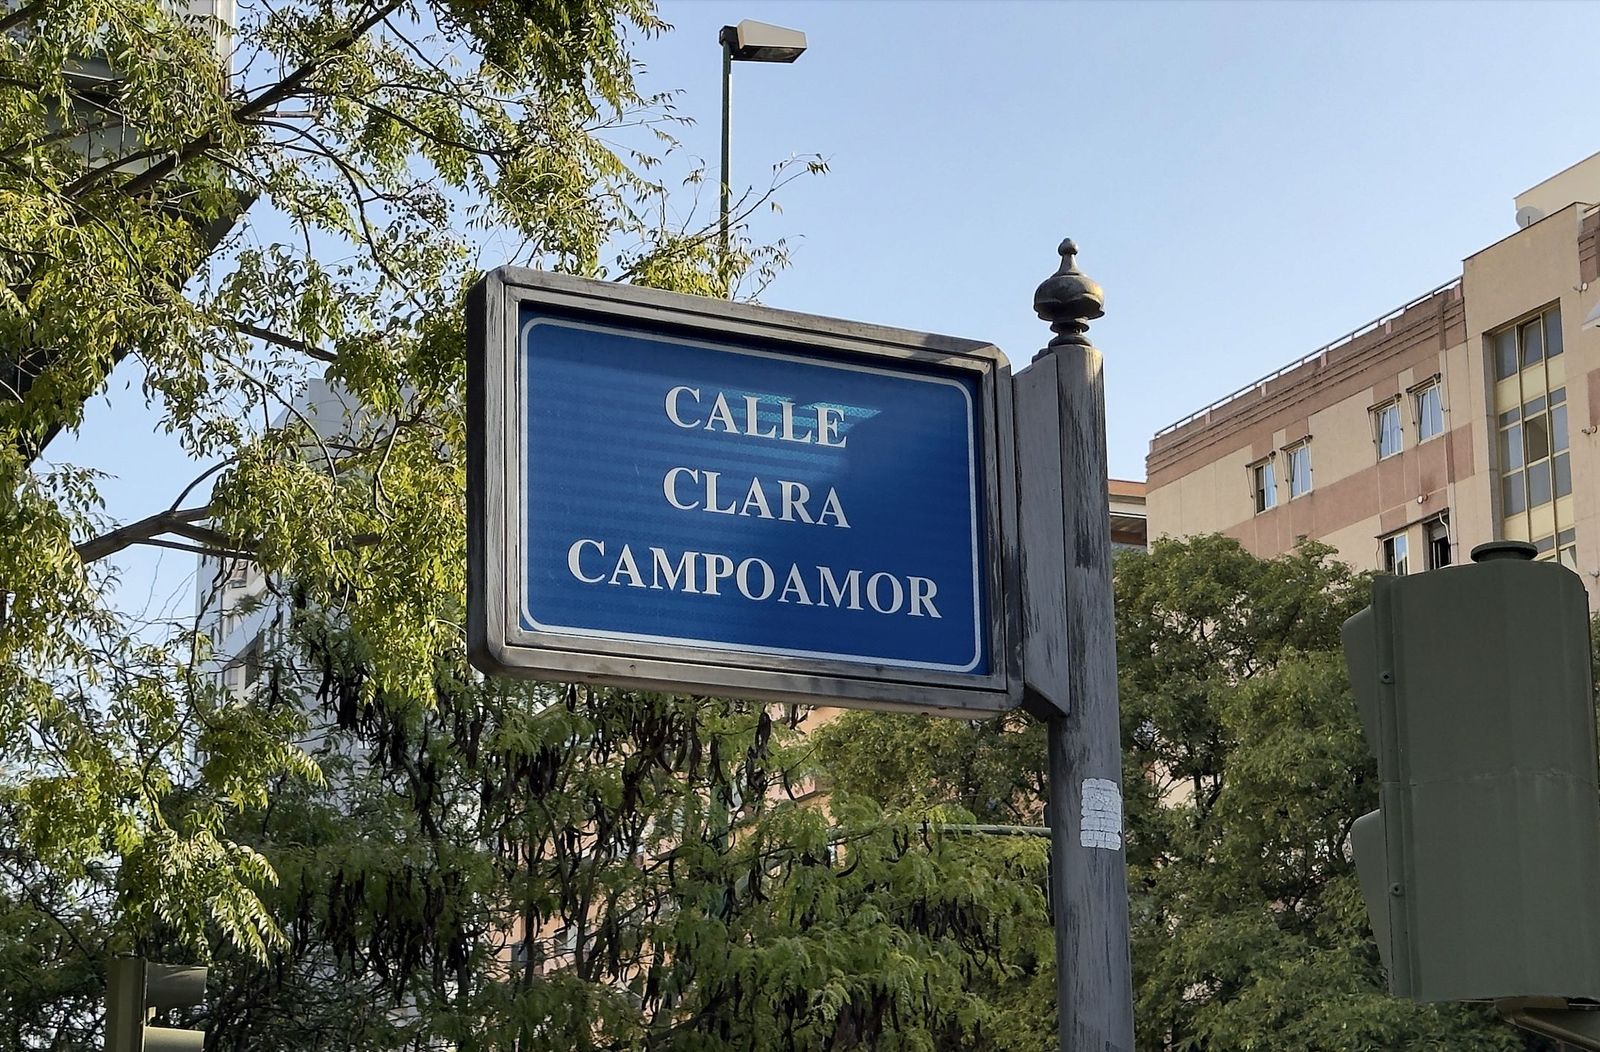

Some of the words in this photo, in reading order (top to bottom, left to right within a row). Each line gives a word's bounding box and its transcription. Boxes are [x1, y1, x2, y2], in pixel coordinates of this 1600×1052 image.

[664, 386, 848, 449] CALLE
[663, 466, 851, 529] CLARA
[567, 539, 942, 619] CAMPOAMOR
